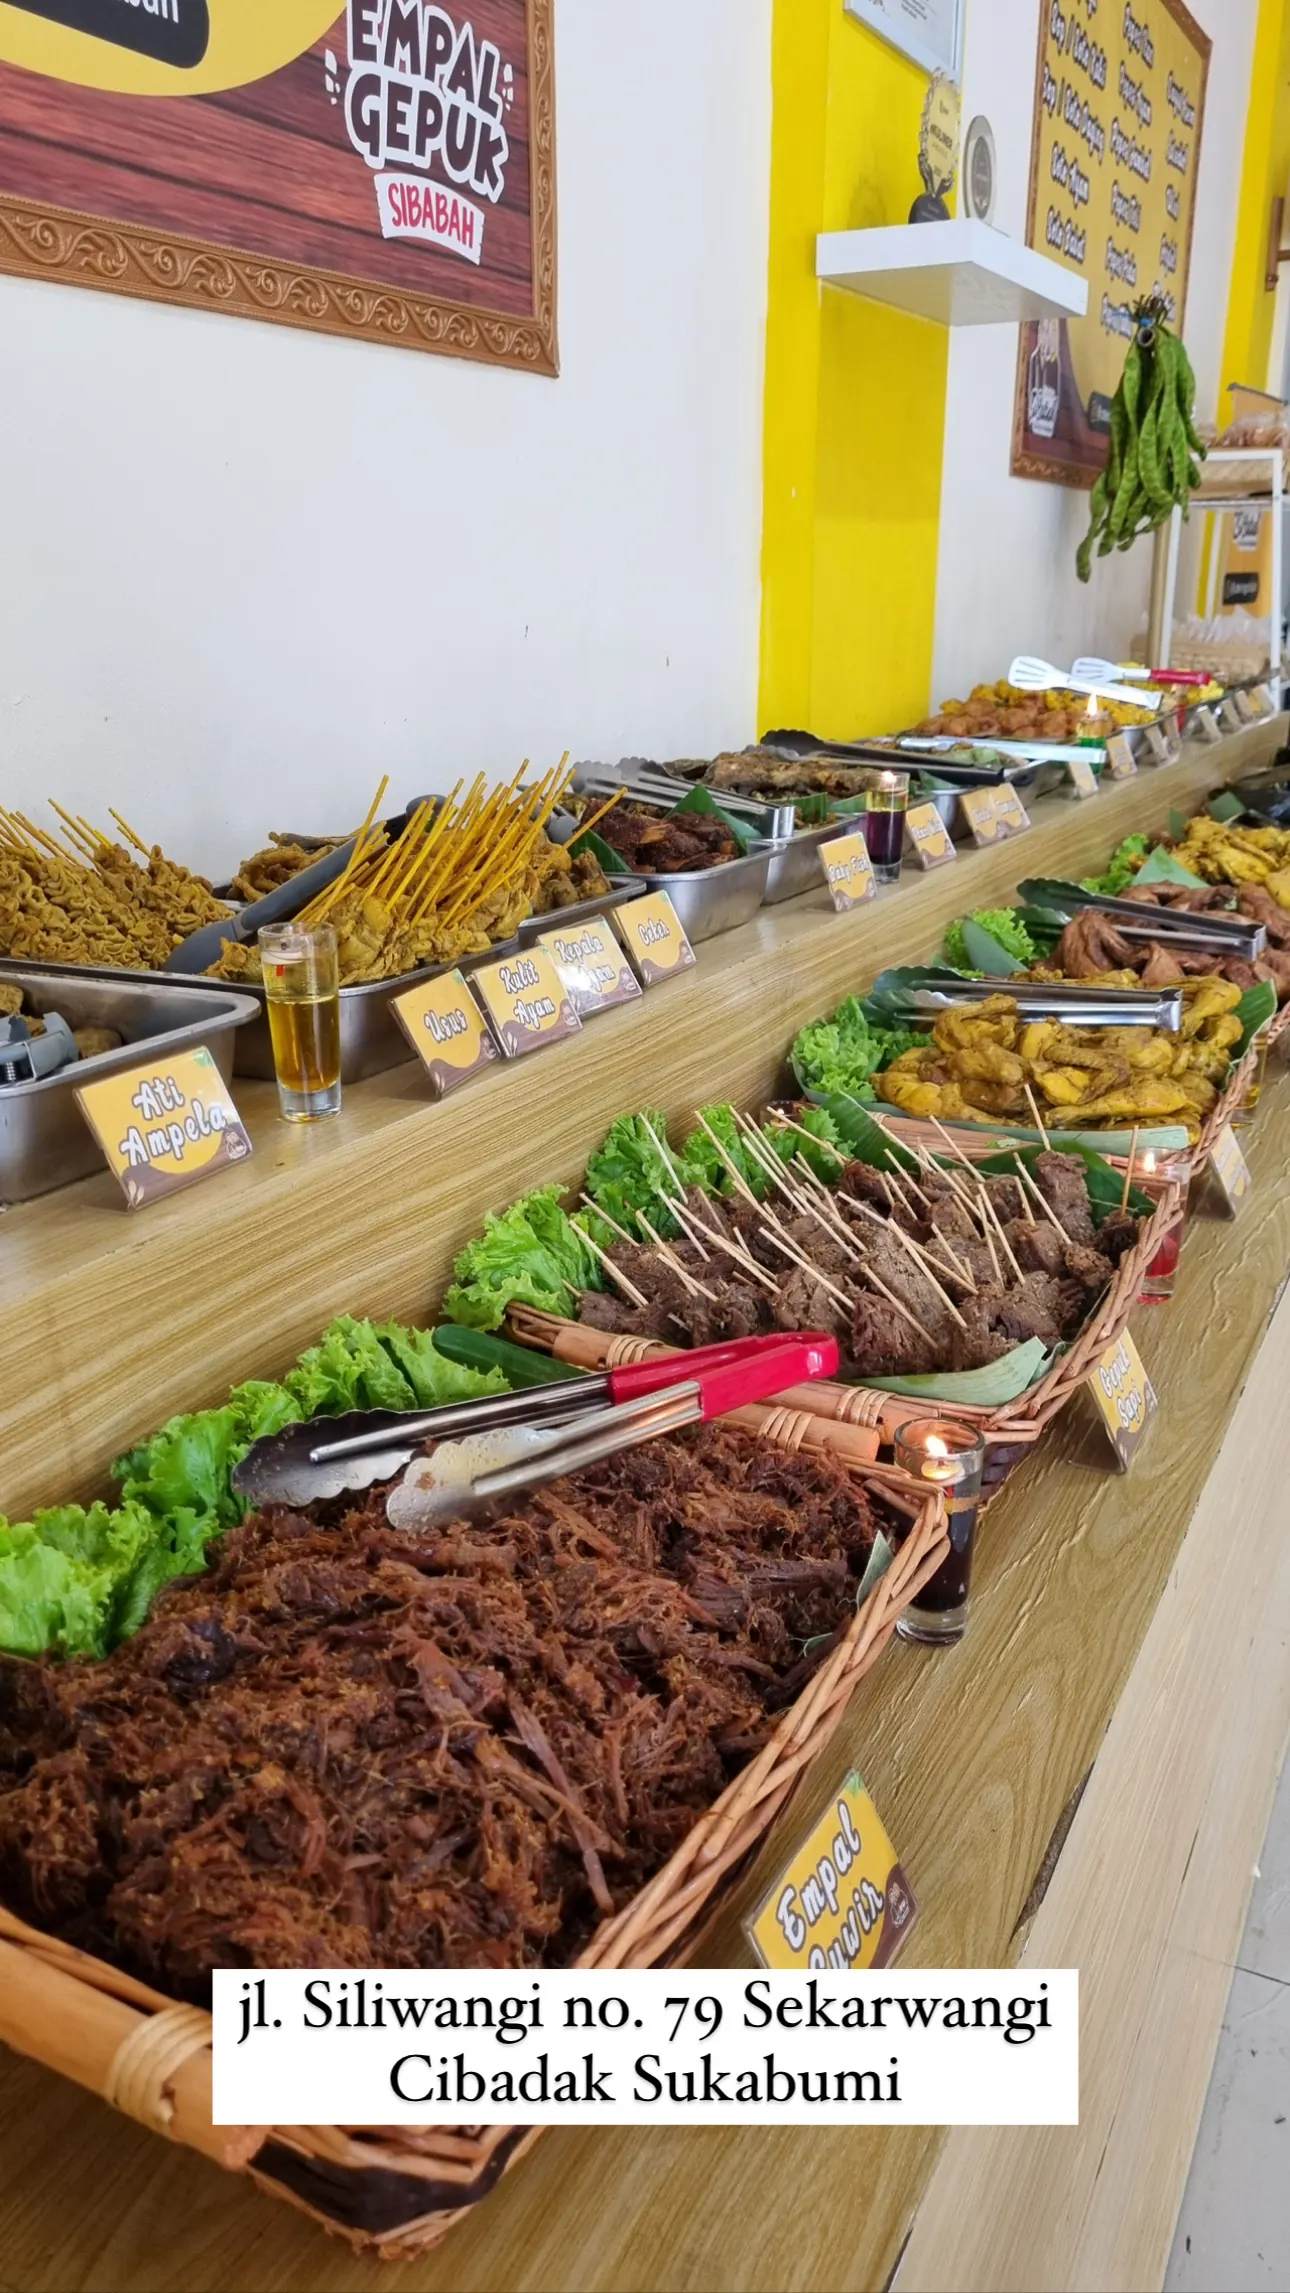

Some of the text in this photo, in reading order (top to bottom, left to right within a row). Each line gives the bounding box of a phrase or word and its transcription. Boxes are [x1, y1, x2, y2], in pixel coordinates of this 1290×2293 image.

[348, 0, 502, 124] EMPAL
[347, 70, 507, 198] GEPUK
[387, 181, 476, 250] SIBABAH
[553, 929, 605, 965] Kepala
[499, 958, 540, 995] Kulit
[423, 1007, 468, 1044] Usus
[513, 996, 556, 1030] Ayam
[132, 1076, 186, 1121] Ati
[118, 1098, 229, 1168] Ampela
[775, 1799, 862, 1953] Empal
